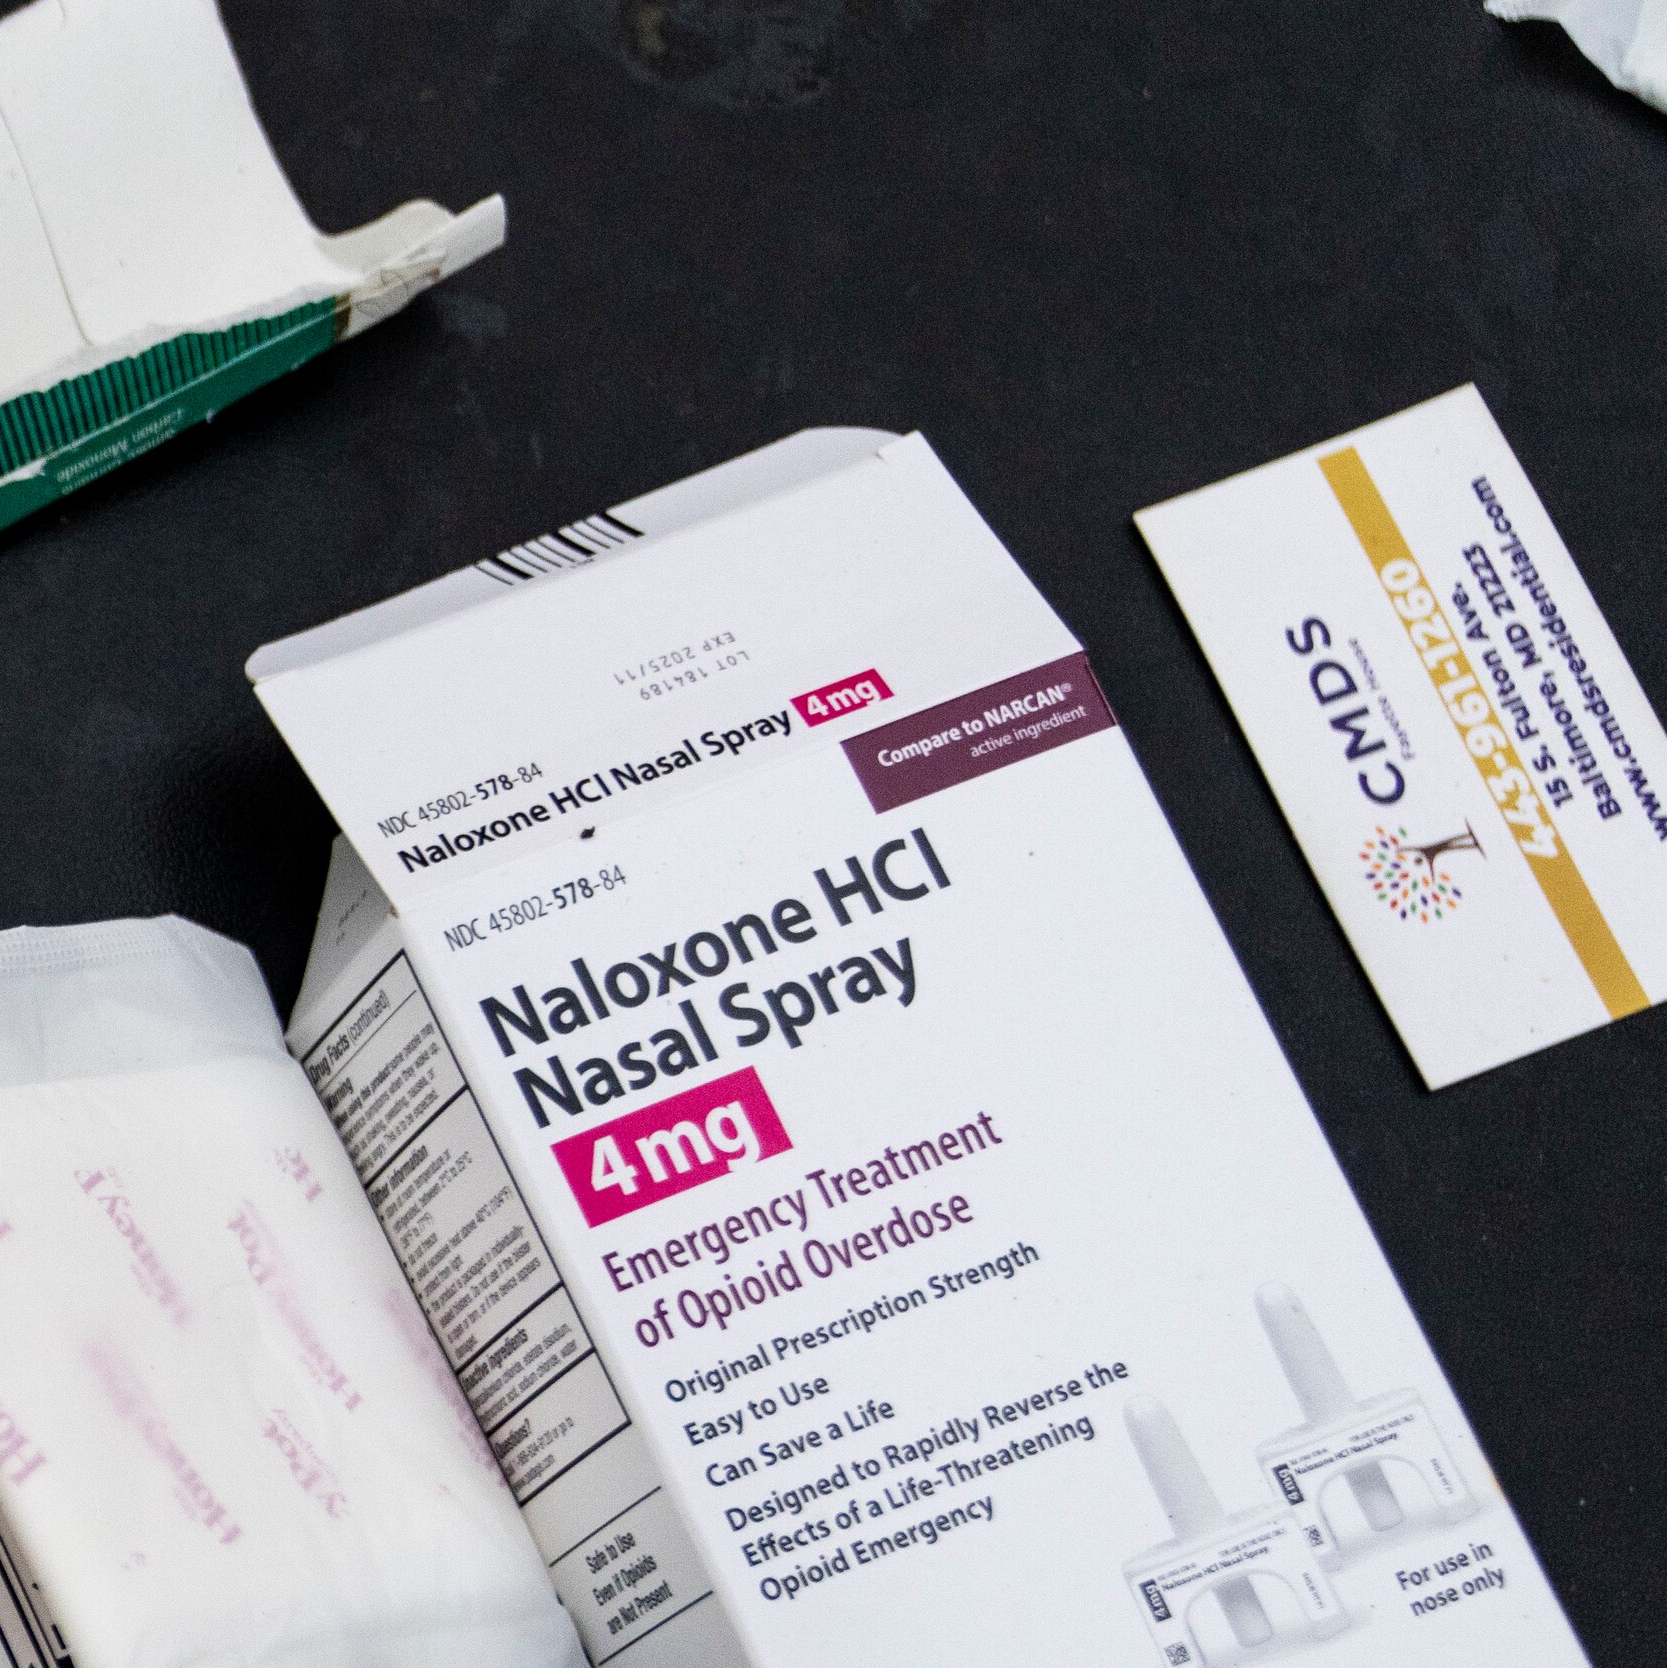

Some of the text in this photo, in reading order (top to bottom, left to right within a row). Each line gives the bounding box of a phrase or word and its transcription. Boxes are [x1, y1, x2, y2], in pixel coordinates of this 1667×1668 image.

[613, 631, 737, 686] EXP 2025/11
[639, 649, 750, 702] LOT 184189
[1285, 617, 1406, 806] CMDS
[1348, 638, 1414, 761] Fayette House
[1379, 555, 1563, 861] 443-961-1260
[1452, 583, 1574, 808] 15 S. Fulton Ave.
[1463, 544, 1622, 820] Baltimore, MD 21223
[397, 680, 882, 874] Naloxone HCl Nasal Spray 4mg
[877, 723, 962, 767] Compare
[957, 719, 984, 736] to
[970, 704, 1088, 758] active ingredient
[376, 761, 543, 838] NDC 45802-578-84
[443, 864, 627, 952] NDC 45802-578-84
[478, 826, 952, 1058] Naloxone HCl
[512, 936, 917, 1130] Nasal Spray
[591, 1100, 762, 1196] 4mg
[601, 1110, 1004, 1293] Emergency Treatment
[634, 1194, 974, 1349] of Opioid Overdose
[664, 1241, 1040, 1403] Original Prescription Strength
[683, 1377, 831, 1447] Easy to Use
[705, 1398, 895, 1488] Can Save a Life
[724, 1361, 1129, 1533] Designed to Rapidly Reverse the
[740, 1416, 1096, 1568] Effects of a Life-Threatening
[759, 1496, 994, 1602] Opioid Emergency
[1395, 1543, 1494, 1591] For use in
[1410, 1567, 1505, 1617] nose only
